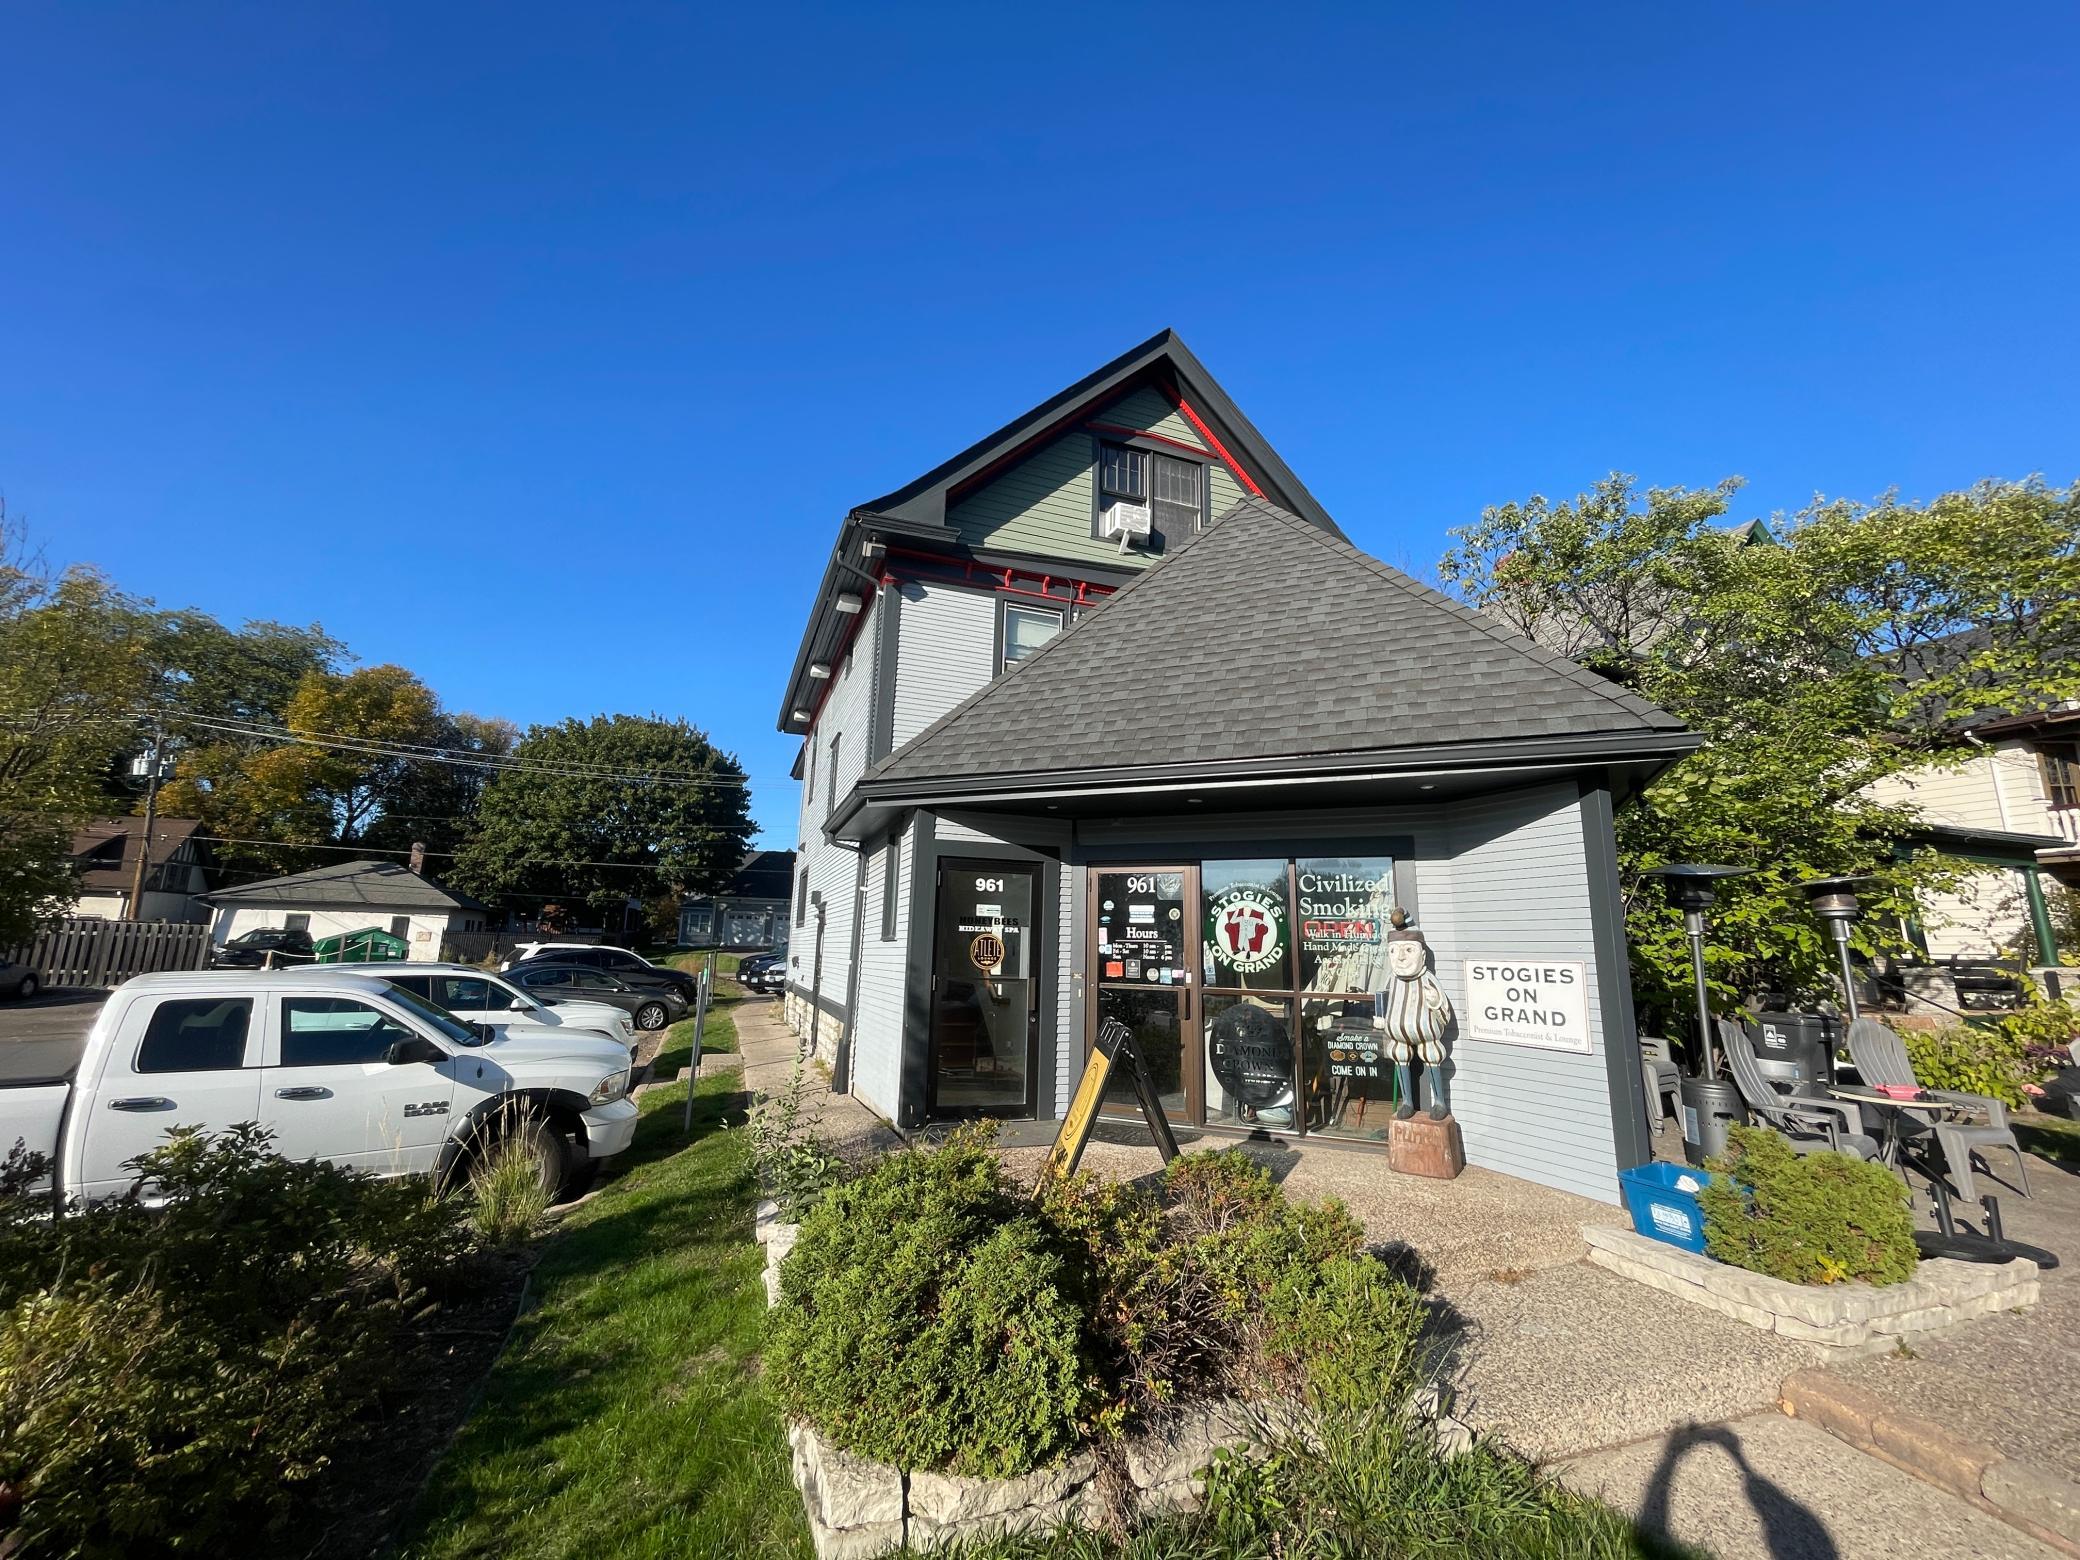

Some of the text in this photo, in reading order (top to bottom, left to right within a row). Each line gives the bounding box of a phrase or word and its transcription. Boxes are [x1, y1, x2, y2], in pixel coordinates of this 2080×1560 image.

[976, 878, 1004, 892] 961
[1127, 876, 1155, 893] 961
[1299, 873, 1389, 892] Civilized
[1211, 891, 1282, 918] STOGIES
[1300, 897, 1390, 920] Smoking
[1126, 927, 1158, 939] Hours
[1307, 929, 1328, 938] Walk
[1332, 930, 1340, 938] in
[1304, 942, 1329, 950] Hand
[1212, 946, 1231, 966] ON
[1233, 947, 1283, 973] GRAND
[1473, 966, 1574, 984] STOGIES
[1506, 988, 1538, 1004] ON
[1484, 1006, 1566, 1026] GRAND
[1336, 1033, 1362, 1042] Smoke
[1474, 1025, 1582, 1046] Premium Tobacconist & Lounge
[1328, 1041, 1378, 1050] DIAMOND CROWN
[1332, 1065, 1378, 1077] COME ON IN
[404, 1101, 450, 1110] RAM
